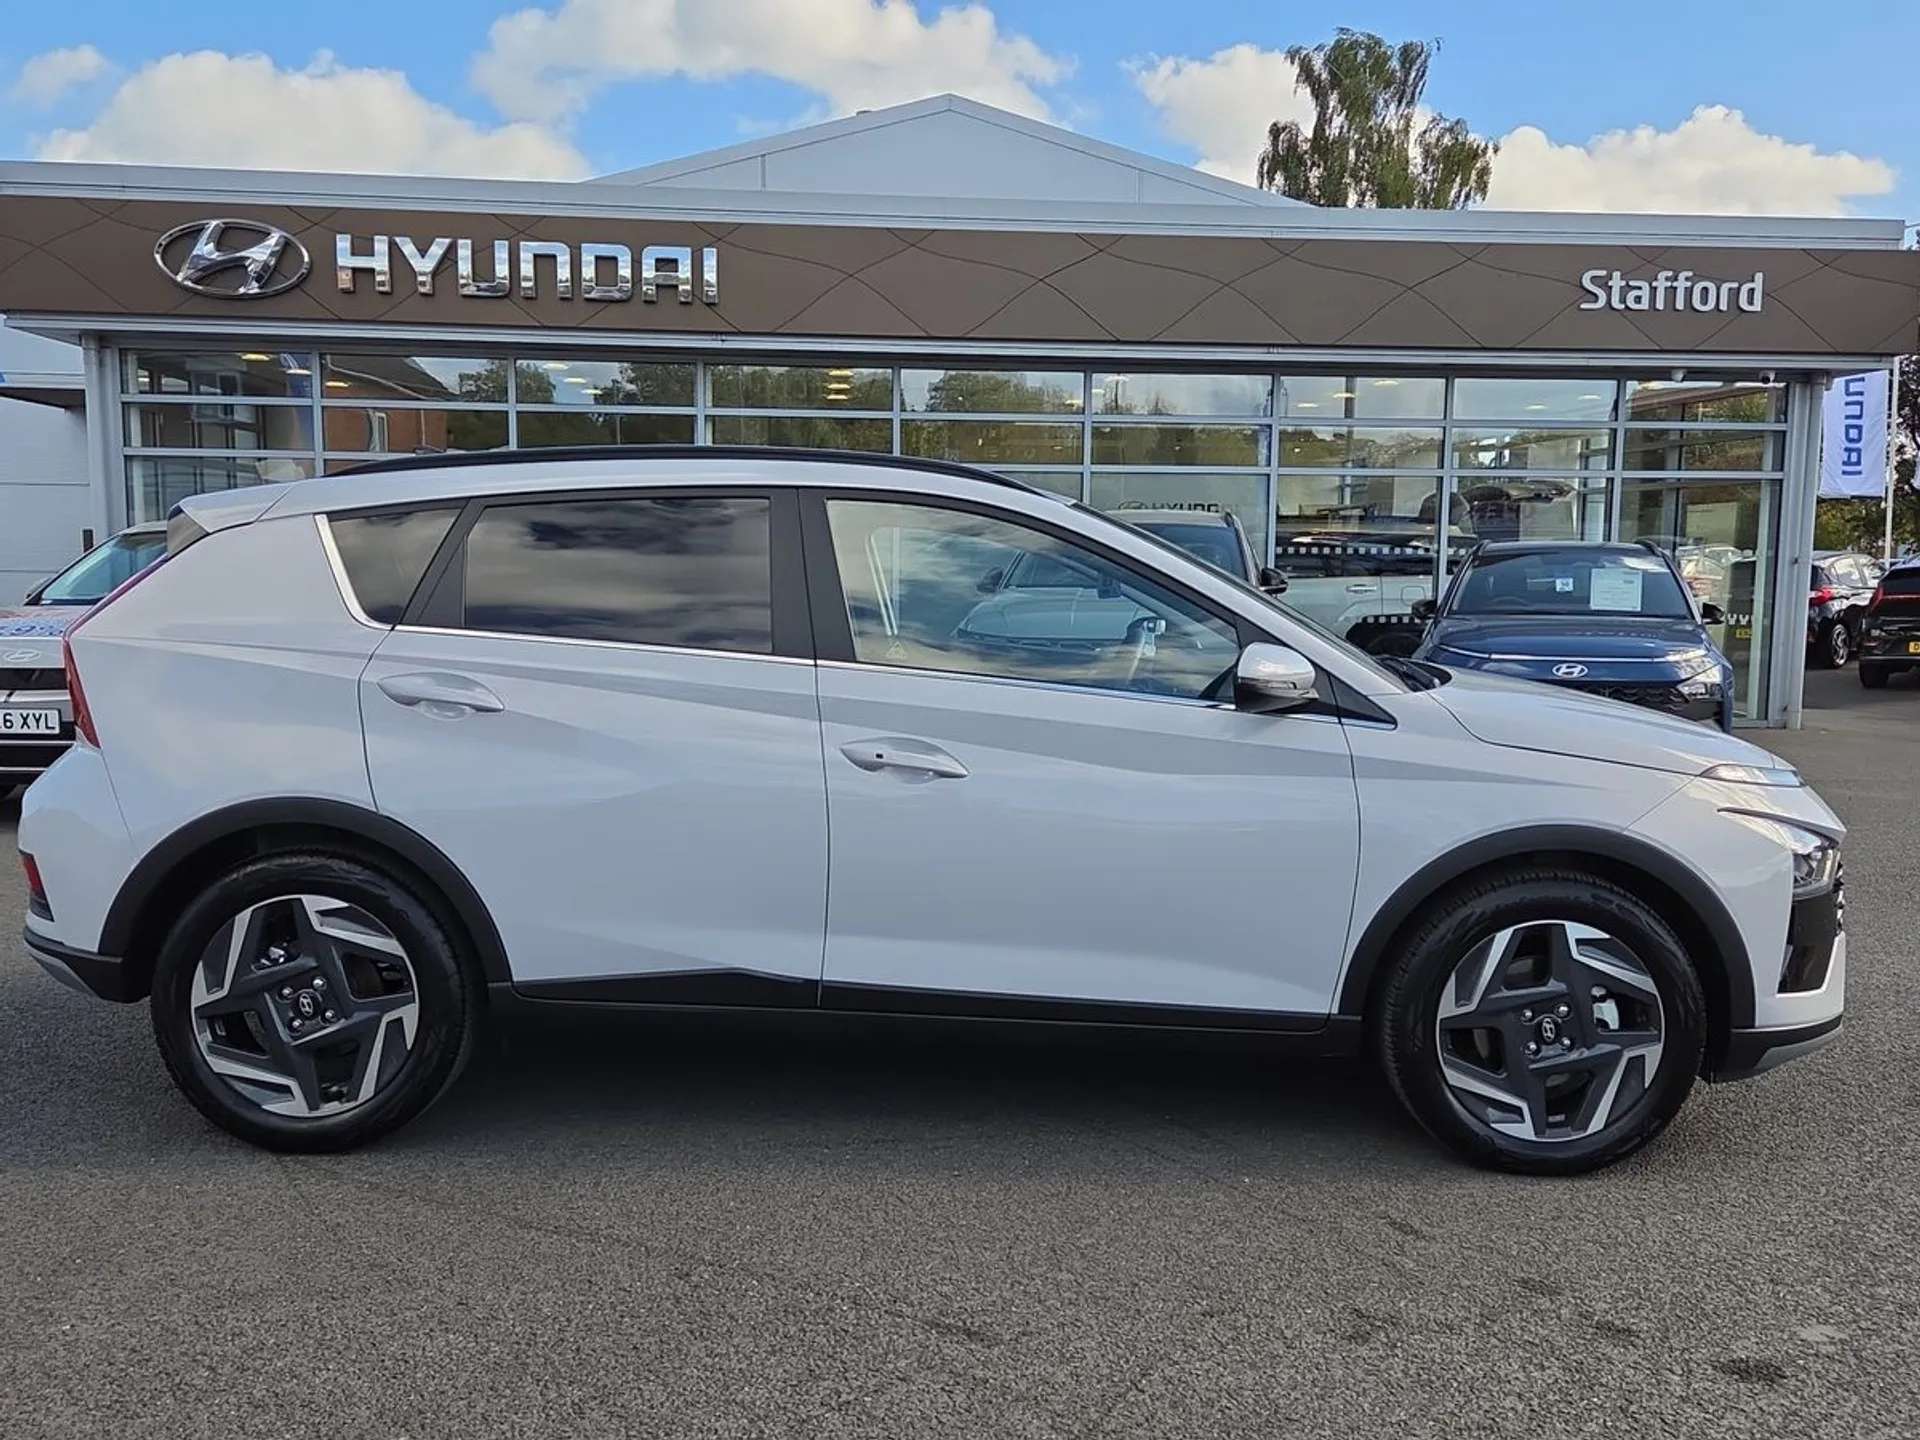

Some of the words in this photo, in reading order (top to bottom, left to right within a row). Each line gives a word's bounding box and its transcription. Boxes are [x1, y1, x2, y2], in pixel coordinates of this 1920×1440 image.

[336, 233, 719, 304] HYUNDAI
[1579, 269, 1764, 312] Stafford
[1151, 502, 1221, 513] HYUND
[0, 712, 14, 730] 6
[19, 712, 56, 730] XYL
